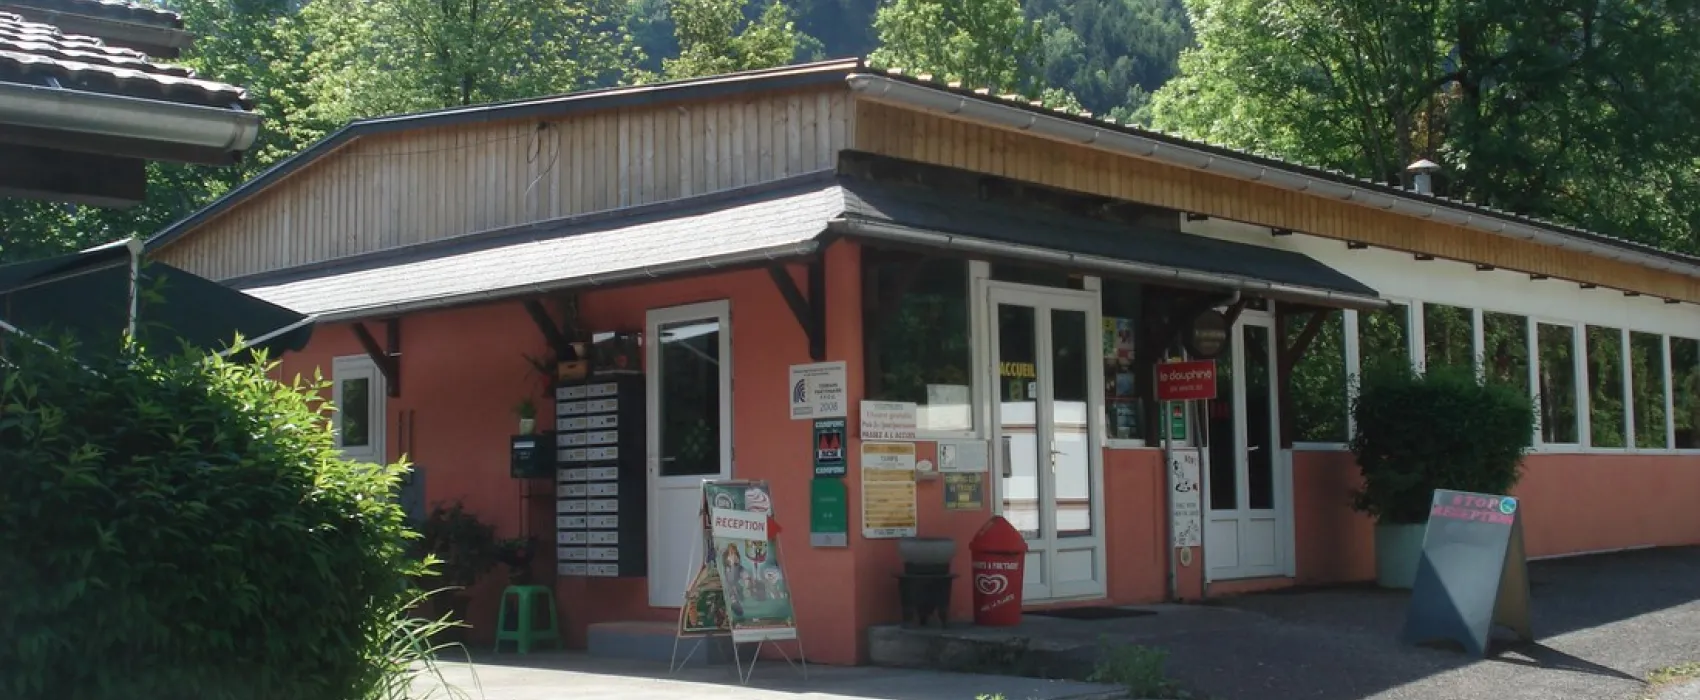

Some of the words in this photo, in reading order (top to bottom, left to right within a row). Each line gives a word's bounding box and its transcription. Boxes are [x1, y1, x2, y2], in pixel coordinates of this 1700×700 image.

[999, 361, 1035, 377] ACCUEIL
[1453, 495, 1499, 509] STOP
[715, 516, 765, 532] RECEPTION
